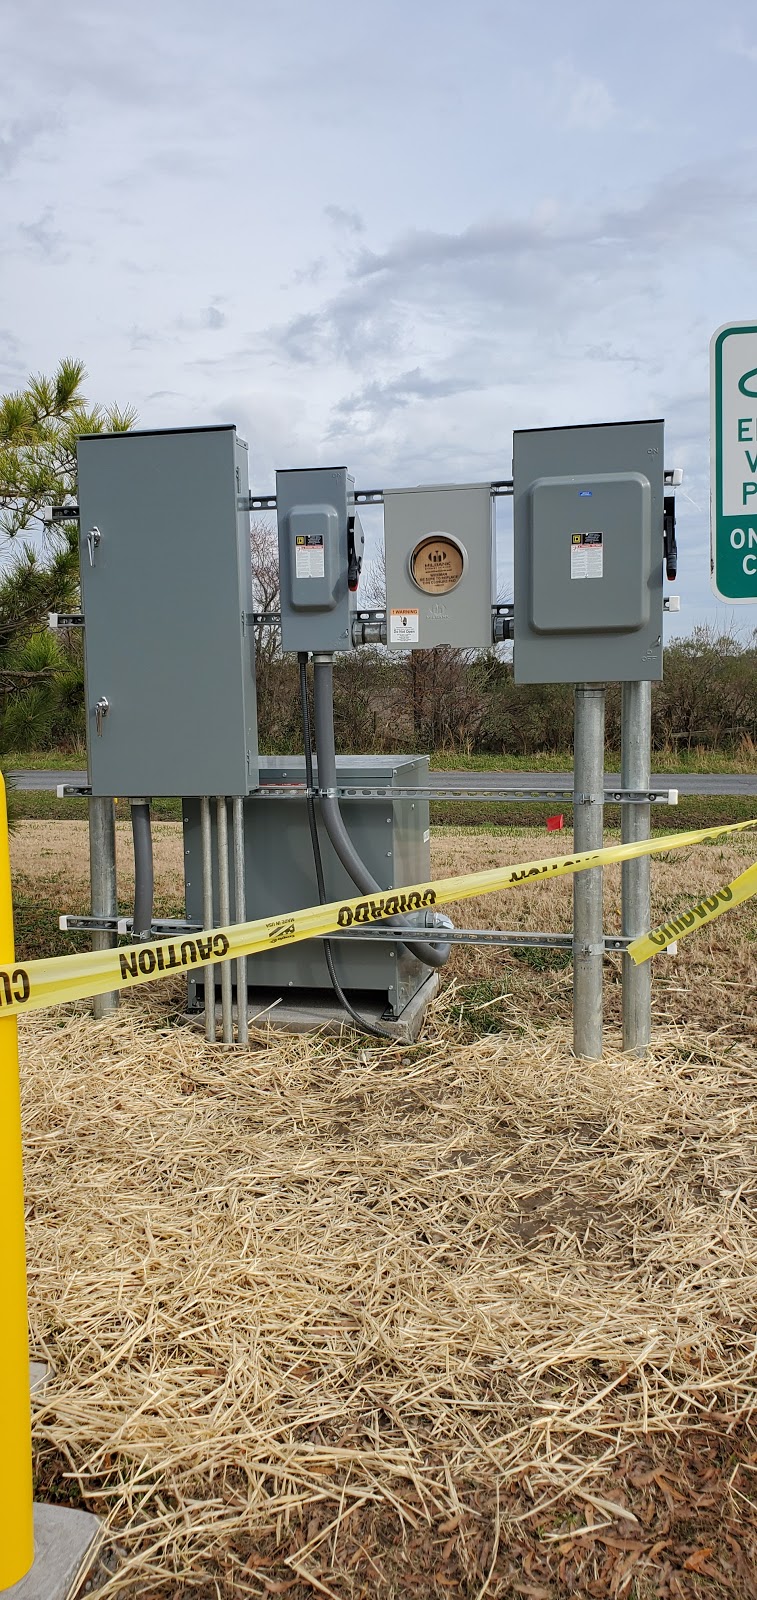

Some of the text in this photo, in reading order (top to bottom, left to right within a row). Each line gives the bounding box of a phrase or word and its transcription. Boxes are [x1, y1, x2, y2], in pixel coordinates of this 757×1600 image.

[738, 418, 757, 442] E
[337, 888, 437, 927] CUIDADO
[119, 933, 230, 980] CAUTION
